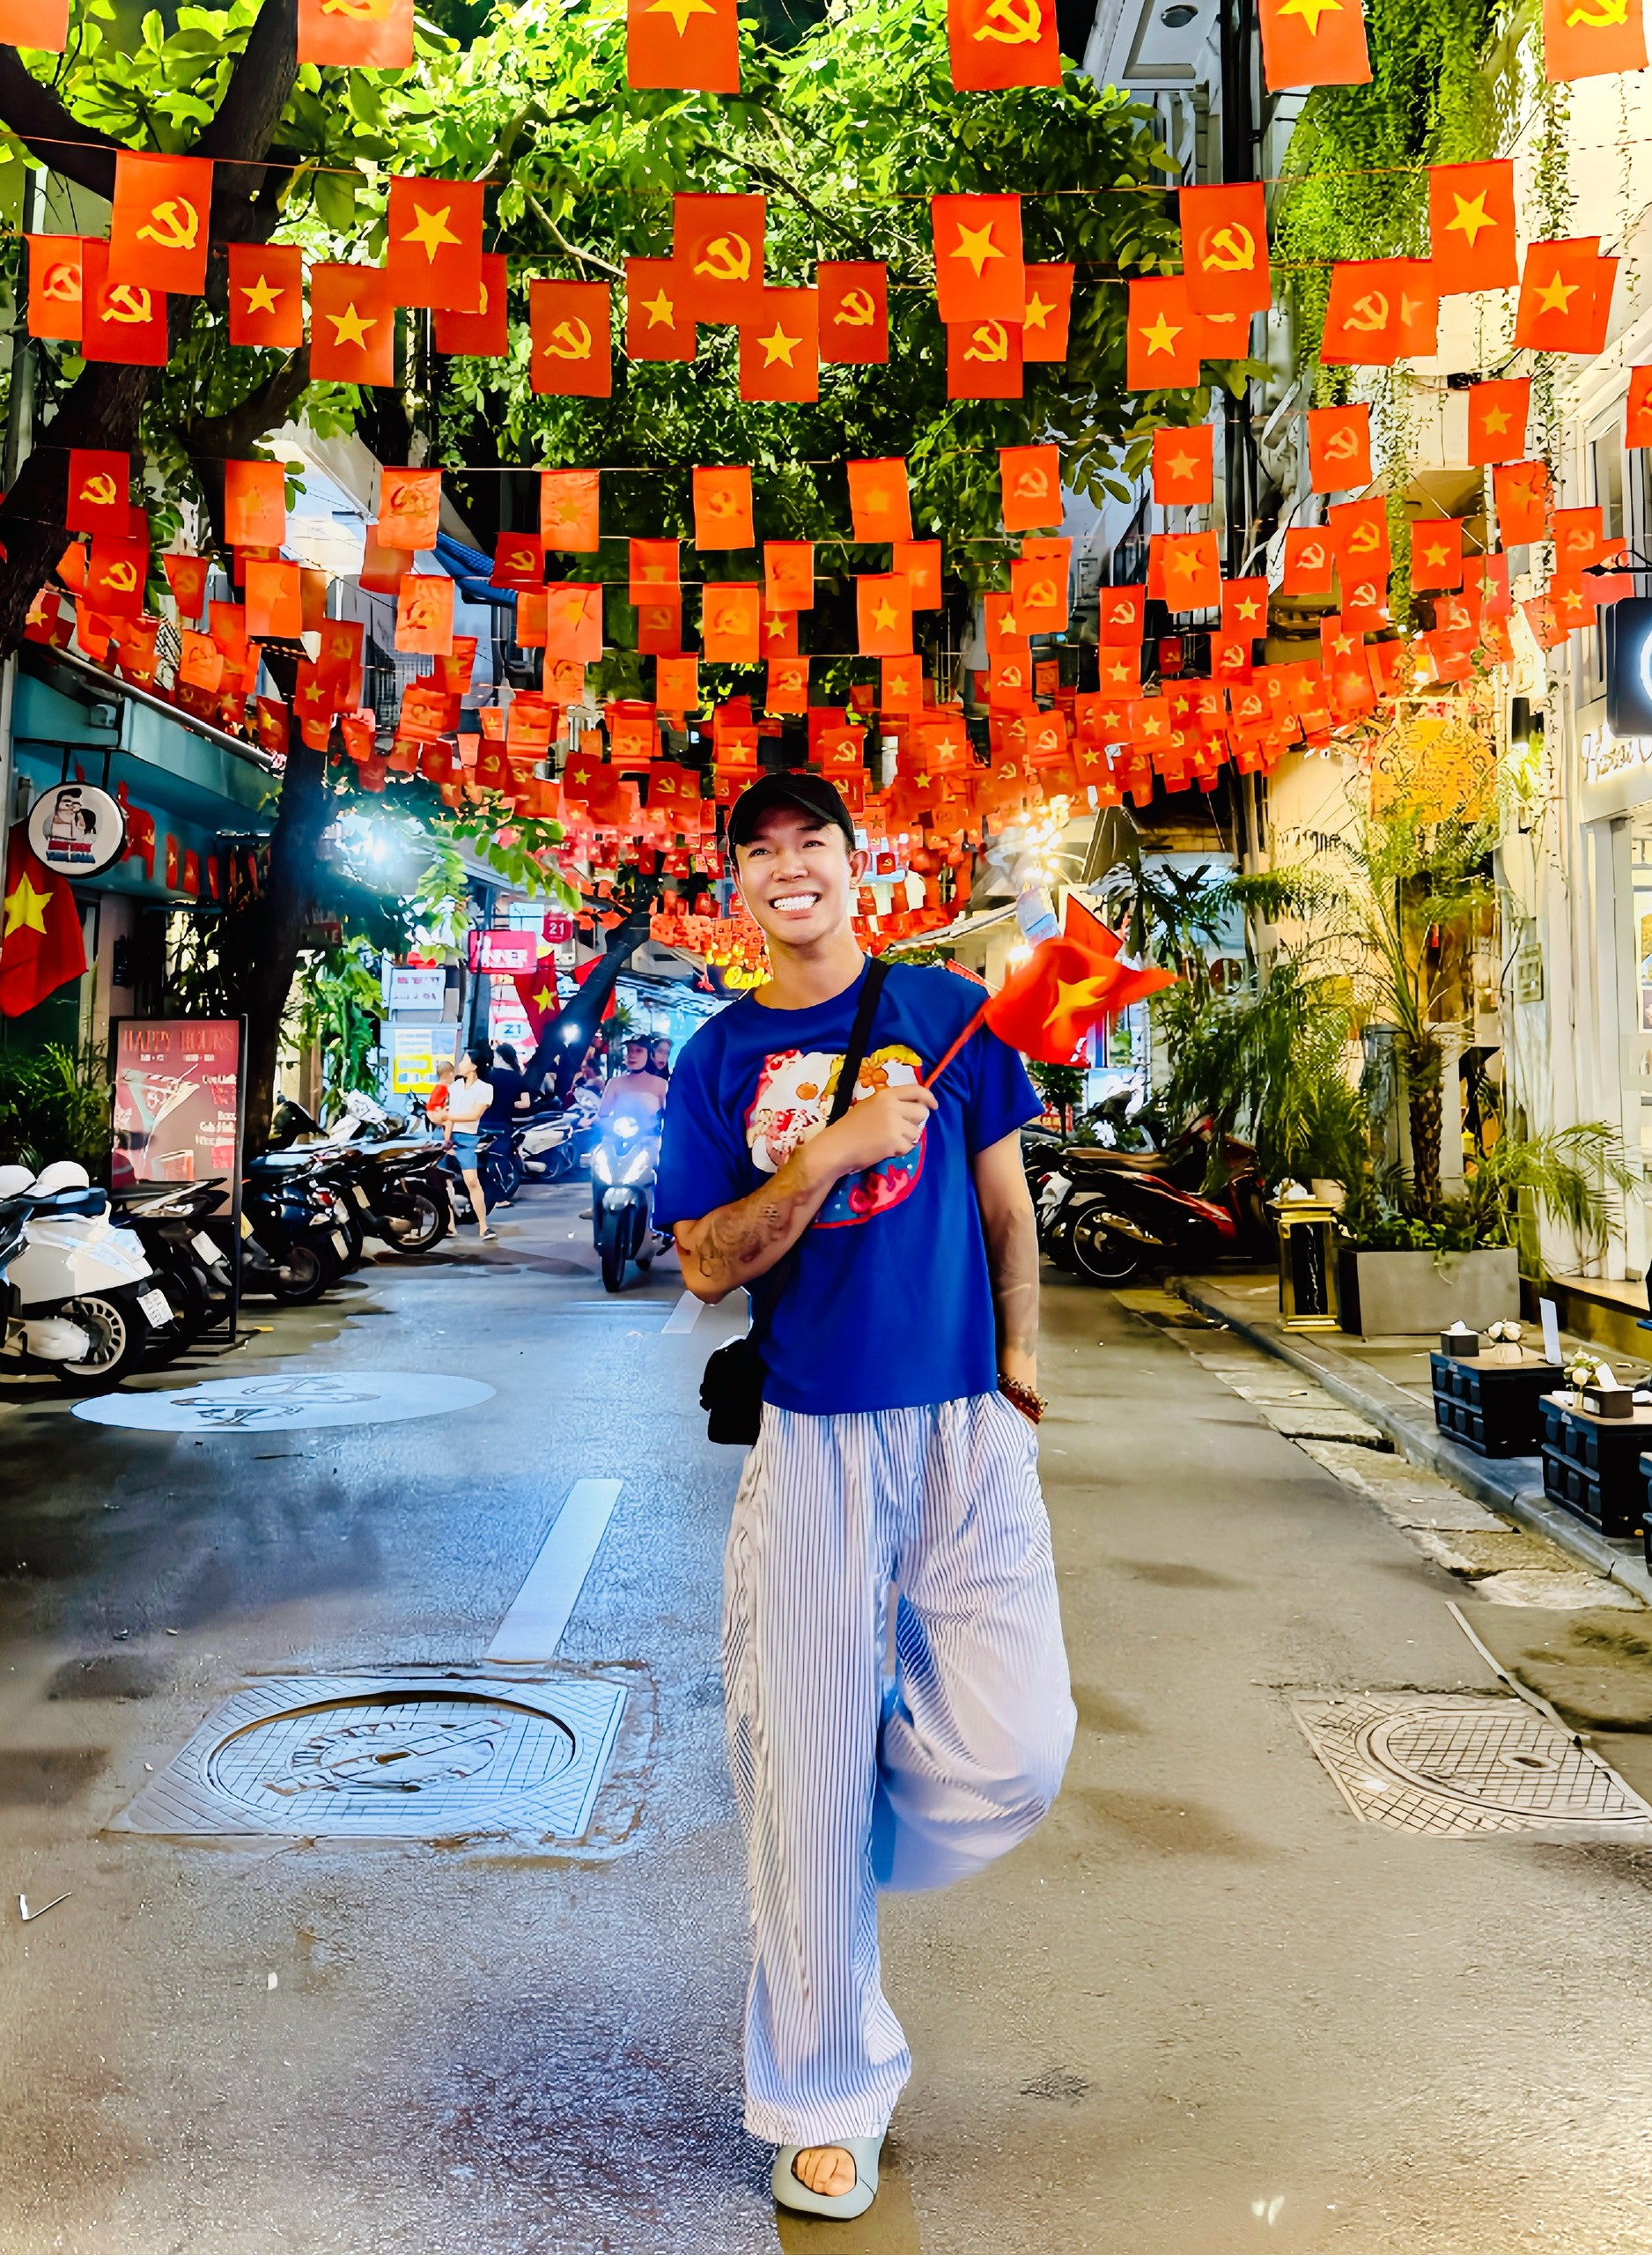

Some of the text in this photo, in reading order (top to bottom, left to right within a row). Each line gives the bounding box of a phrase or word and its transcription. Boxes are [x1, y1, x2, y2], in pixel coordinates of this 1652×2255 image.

[549, 921, 564, 935] 21
[123, 1030, 233, 1053] HAPPY HOURS
